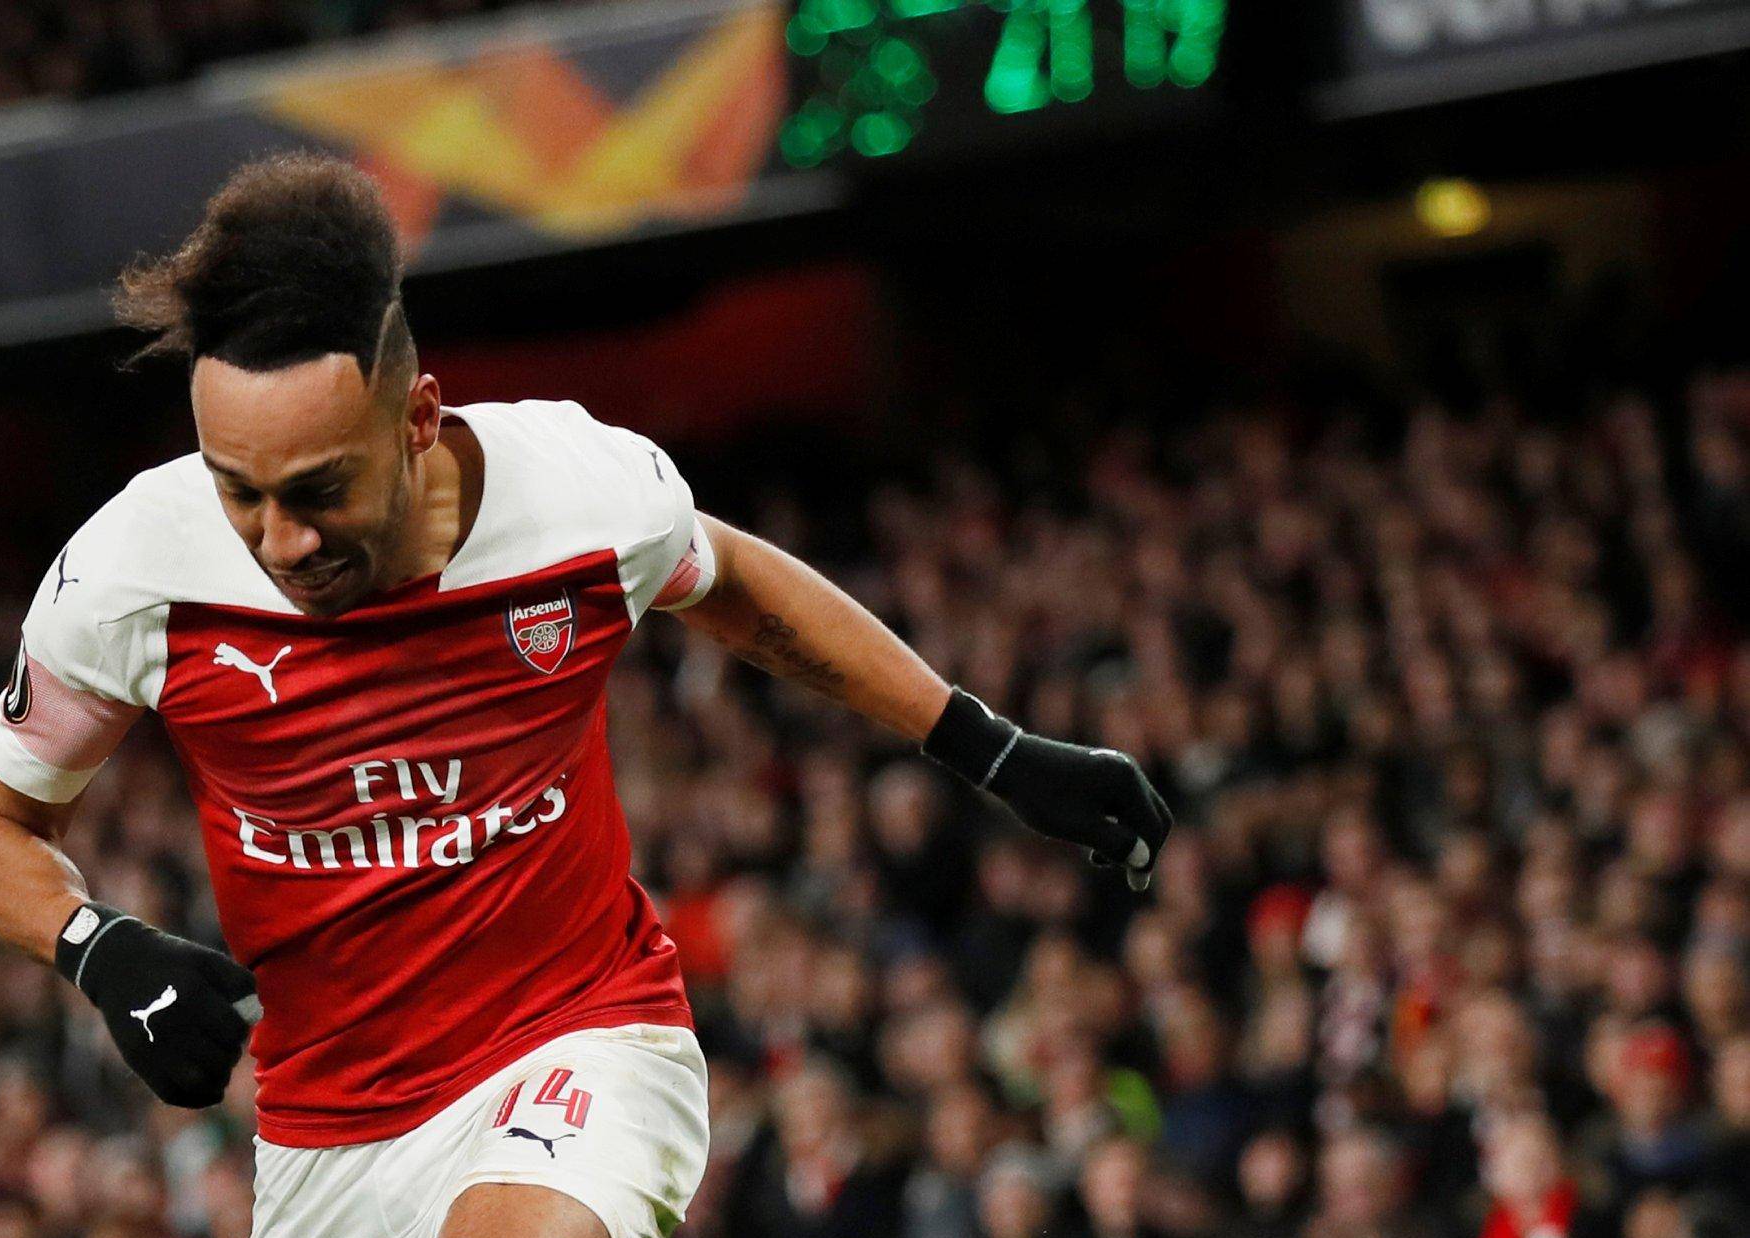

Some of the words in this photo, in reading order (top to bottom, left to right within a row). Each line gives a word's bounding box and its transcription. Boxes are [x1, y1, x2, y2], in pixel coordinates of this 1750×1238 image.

[513, 596, 567, 621] Arsenal
[350, 759, 462, 803] Fly
[492, 1068, 593, 1130] 14
